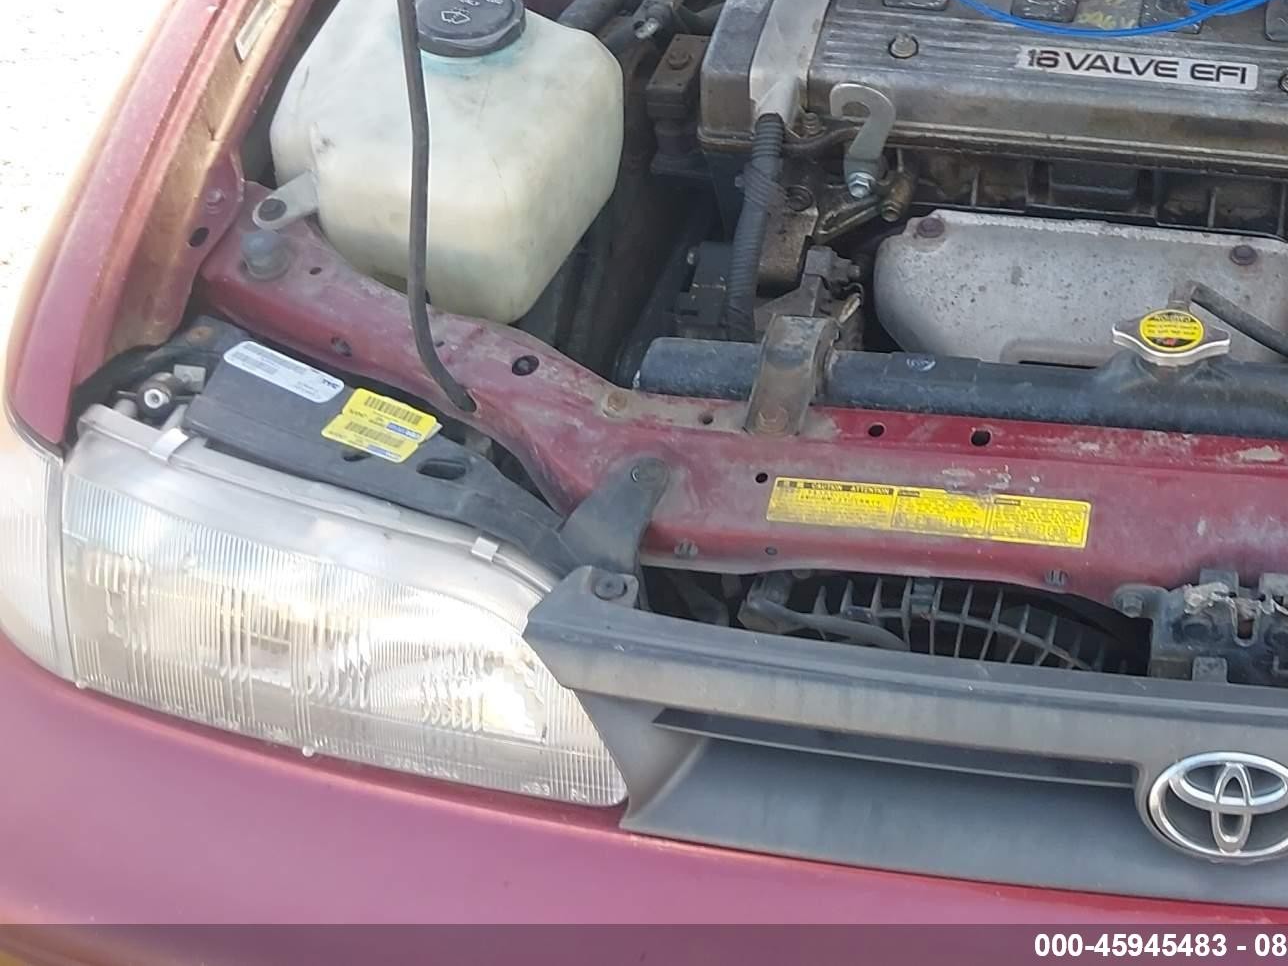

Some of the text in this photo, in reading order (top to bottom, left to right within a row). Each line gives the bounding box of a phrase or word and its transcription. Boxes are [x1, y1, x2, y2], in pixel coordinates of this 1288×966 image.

[1027, 49, 1247, 85] 16 VALVE EFI
